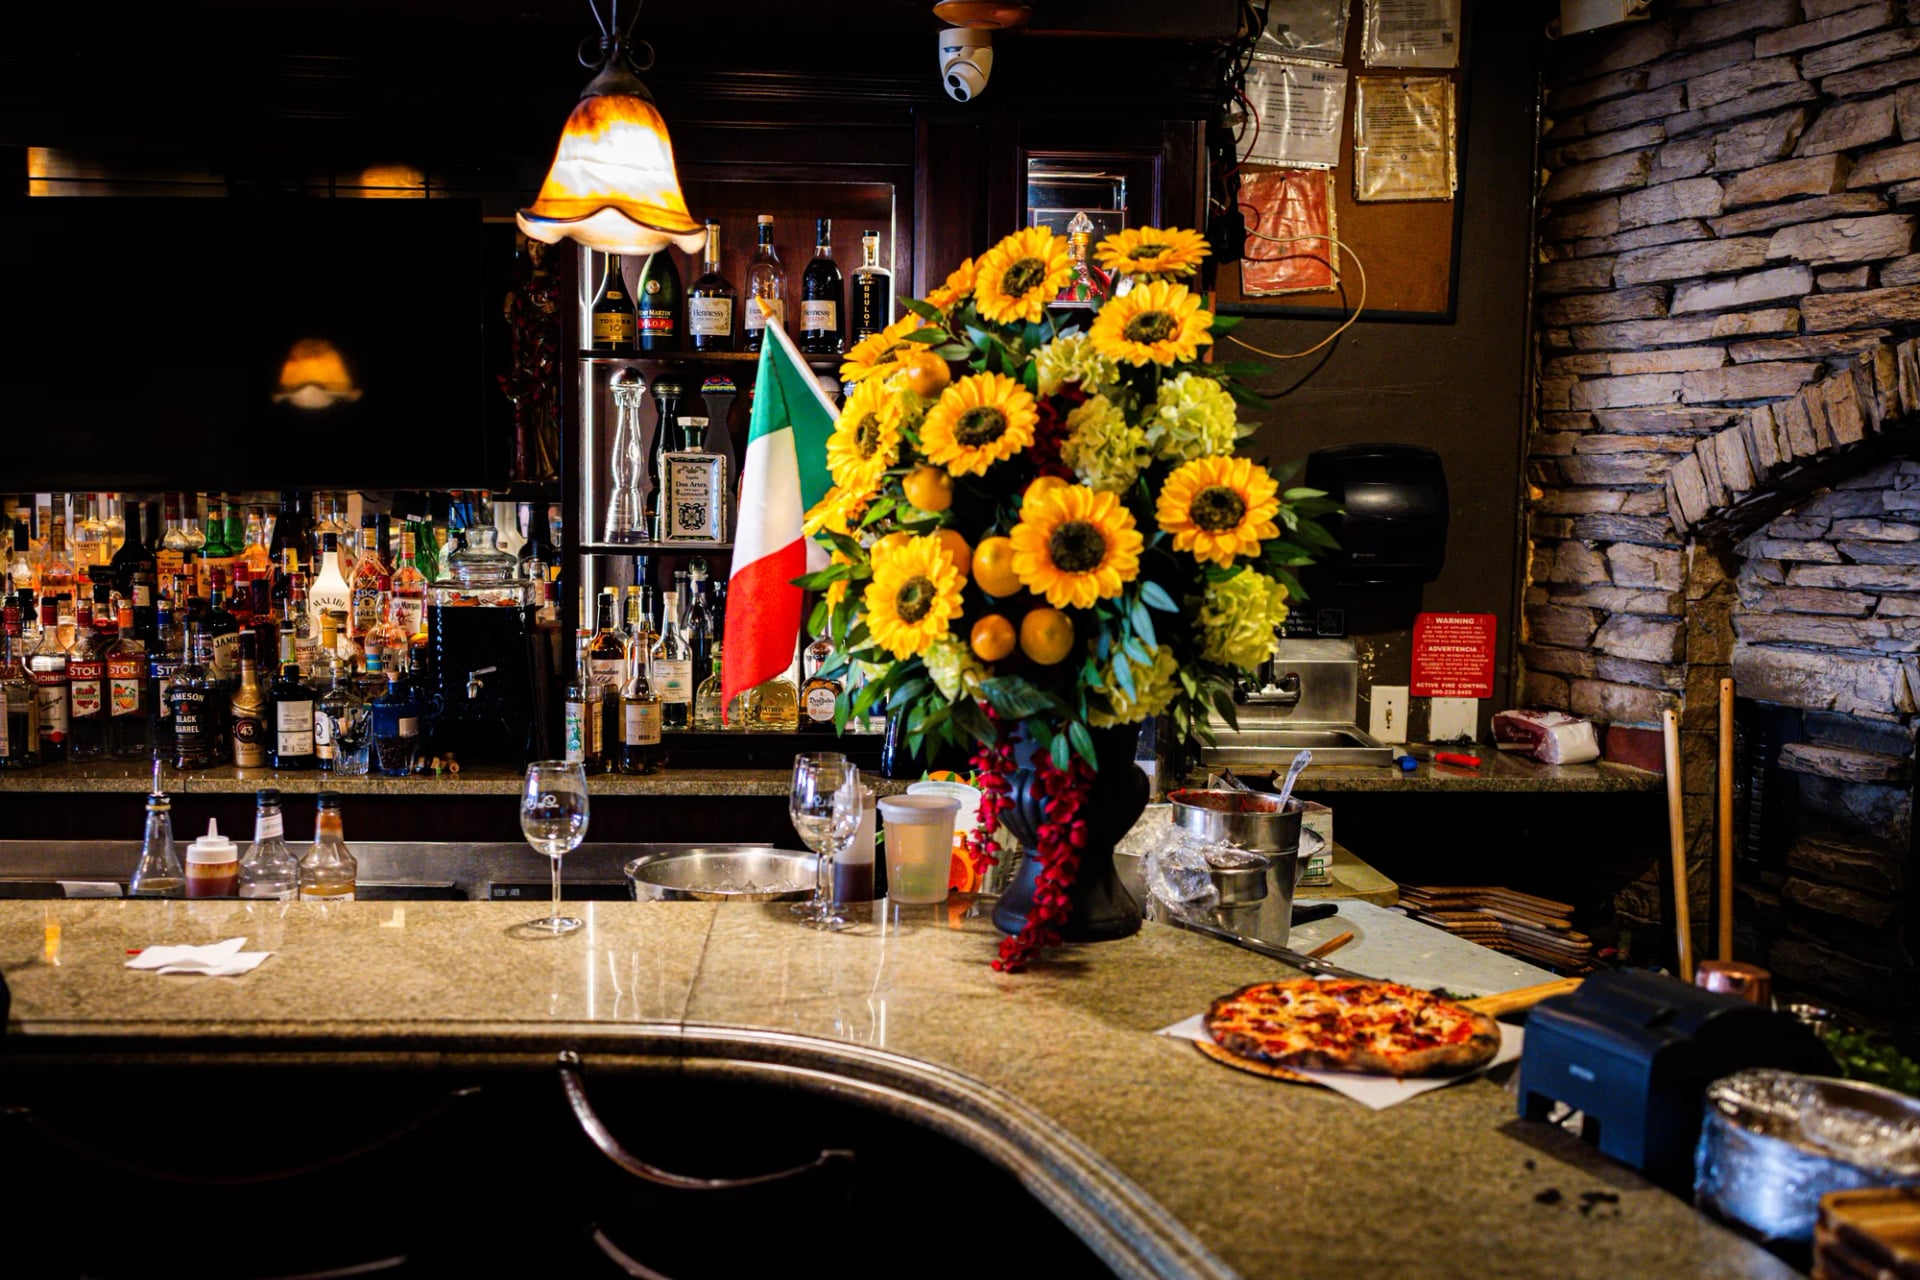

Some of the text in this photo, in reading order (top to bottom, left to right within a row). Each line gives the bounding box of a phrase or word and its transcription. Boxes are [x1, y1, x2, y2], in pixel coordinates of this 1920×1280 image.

[693, 308, 724, 318] Hennessy
[1435, 617, 1475, 625] WARNING
[1428, 645, 1478, 653] ADVERTENCIA
[69, 665, 101, 676] STOLI
[109, 664, 140, 675] STOLI
[170, 692, 205, 702] JAMESON
[175, 725, 199, 733] BARREL
[240, 726, 254, 736] 43
